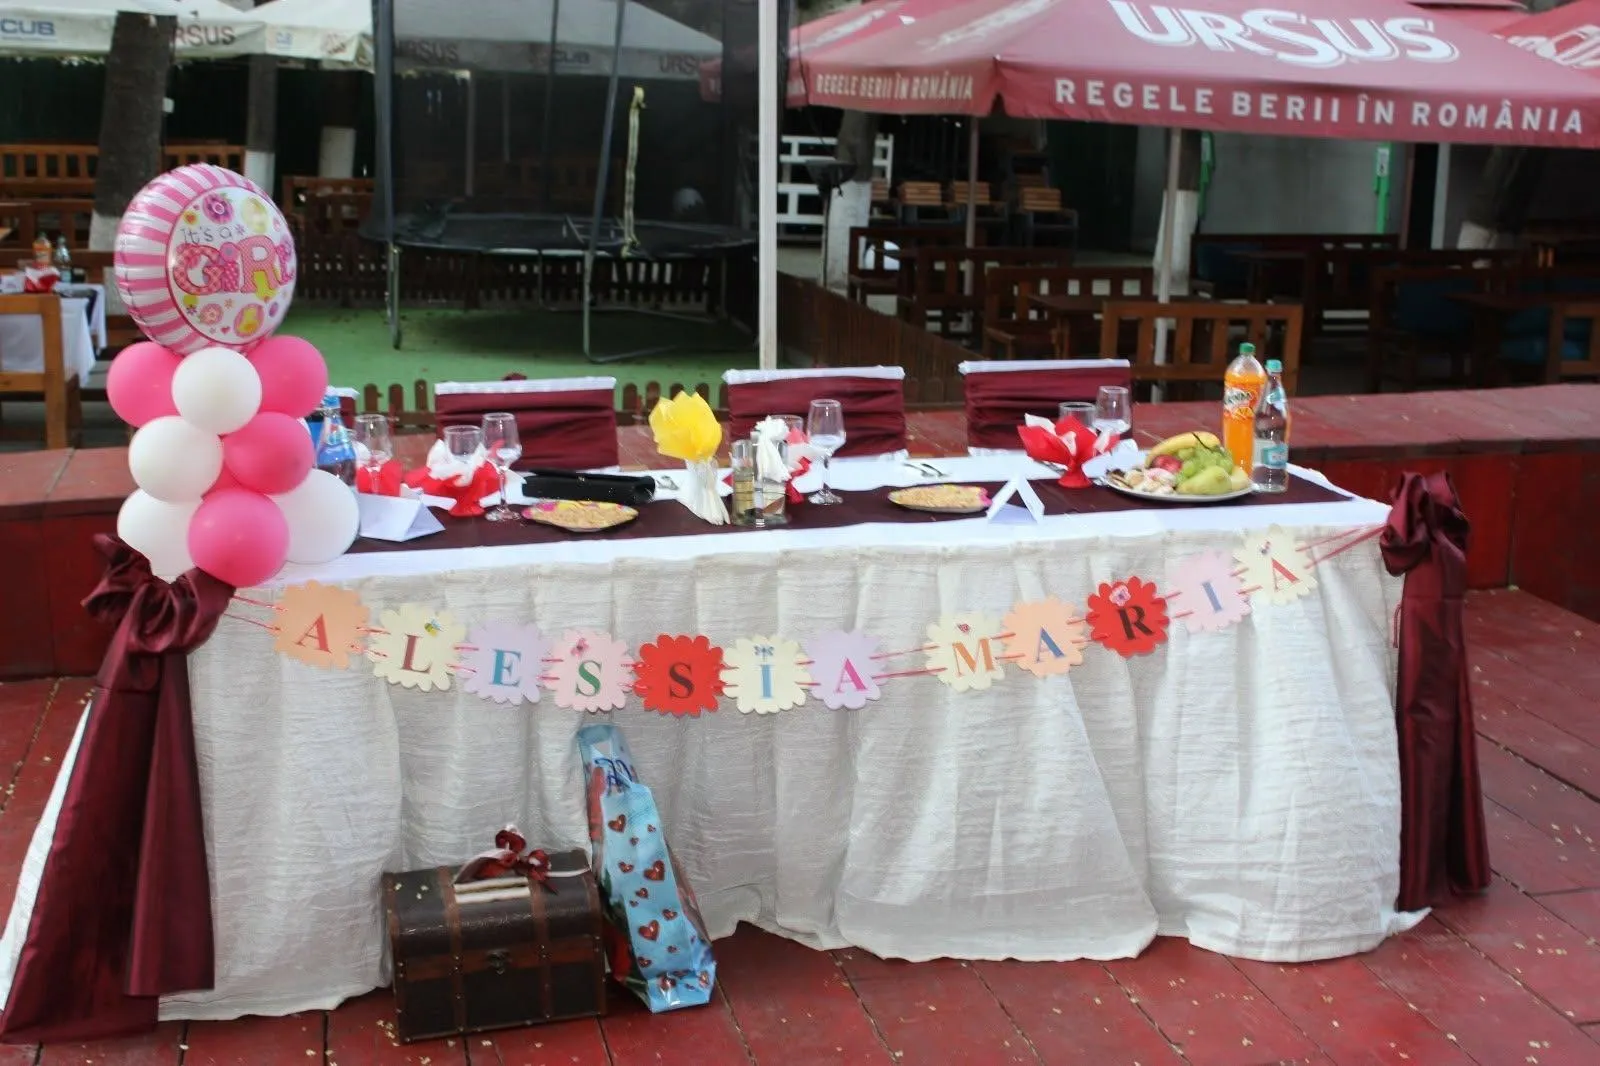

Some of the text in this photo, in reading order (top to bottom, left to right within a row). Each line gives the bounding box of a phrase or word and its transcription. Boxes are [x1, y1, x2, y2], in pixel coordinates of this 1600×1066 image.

[173, 23, 236, 46] RSUS
[1109, 0, 1459, 68] URSUS
[816, 73, 858, 96] REGELE
[1055, 77, 1583, 134] REGELE BERII ÎN ROMÂNIA
